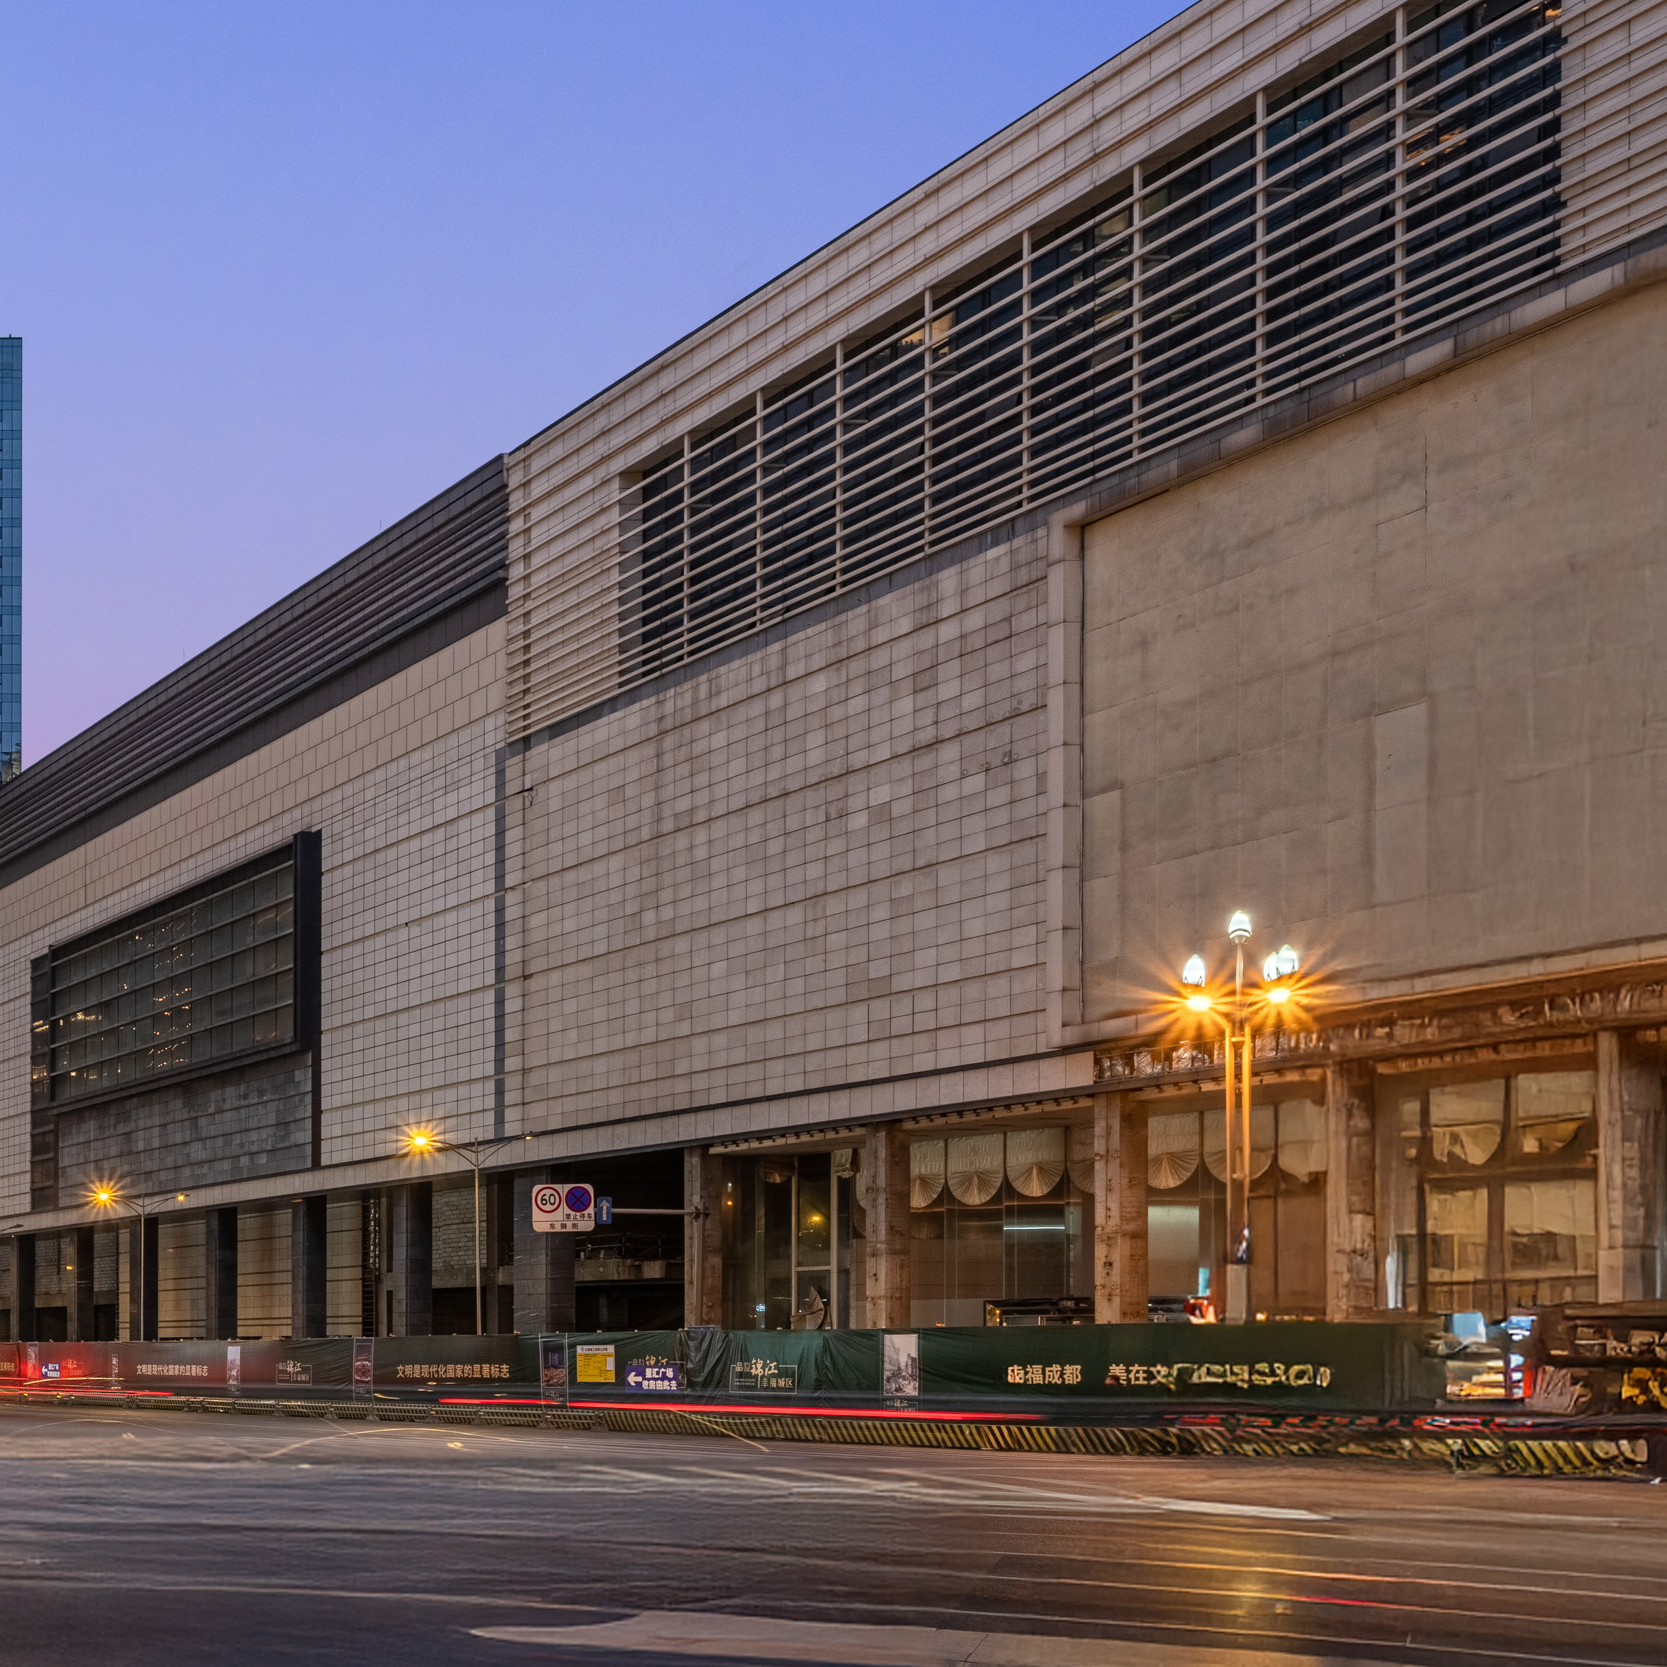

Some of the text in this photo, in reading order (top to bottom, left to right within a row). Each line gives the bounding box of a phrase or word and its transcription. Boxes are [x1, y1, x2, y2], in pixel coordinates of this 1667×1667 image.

[540, 1193, 557, 1206] 60
[565, 1213, 593, 1221] 禁止停车
[136, 1364, 208, 1376] 文明是现代化国家的显著标志
[396, 1364, 510, 1379] 文明是现代化国家的显著标志
